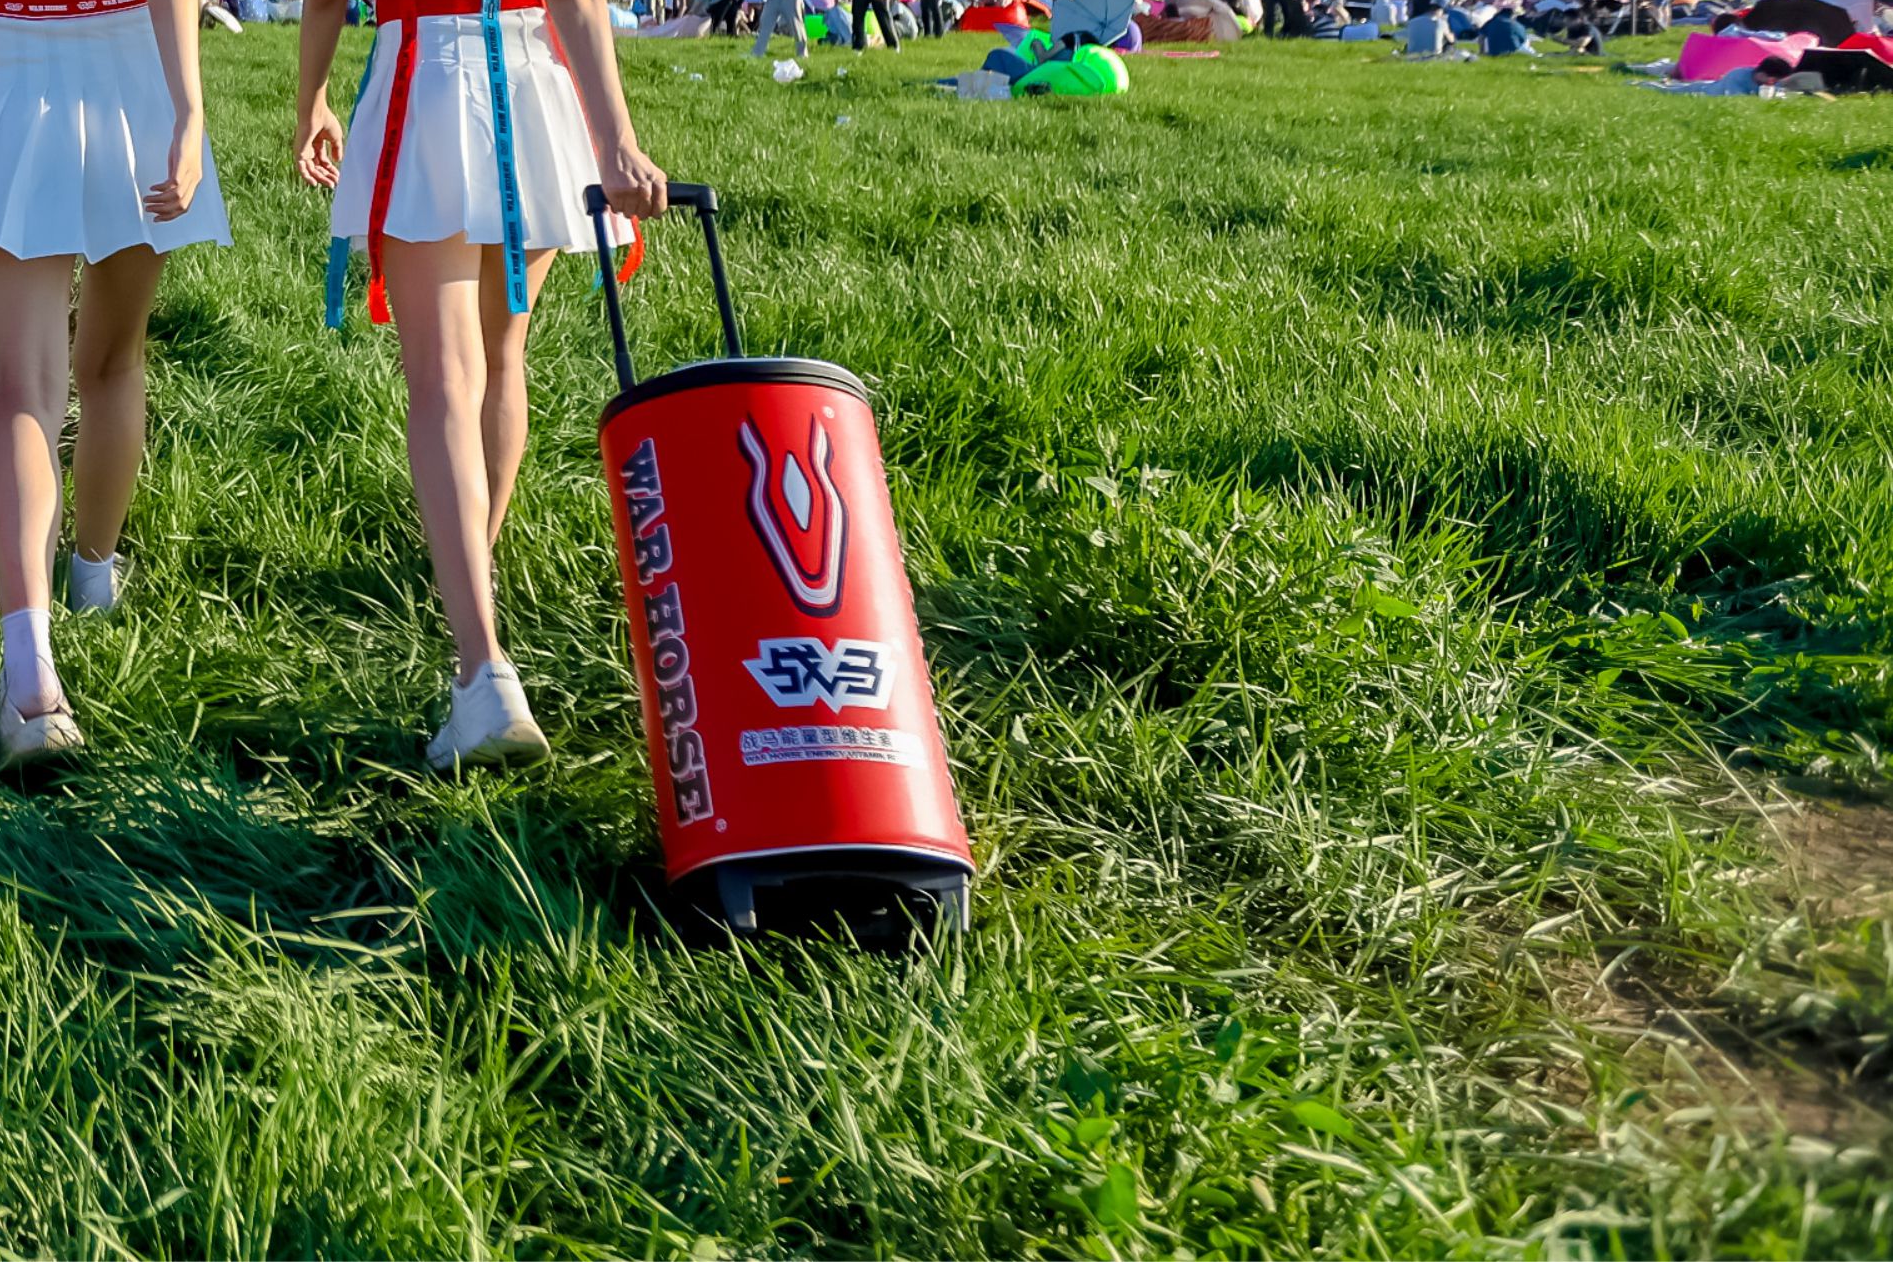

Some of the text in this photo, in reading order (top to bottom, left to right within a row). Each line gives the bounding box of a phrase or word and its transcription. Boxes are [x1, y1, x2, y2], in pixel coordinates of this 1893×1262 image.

[620, 437, 714, 829] WAR HORSE
[755, 642, 888, 702] 战马
